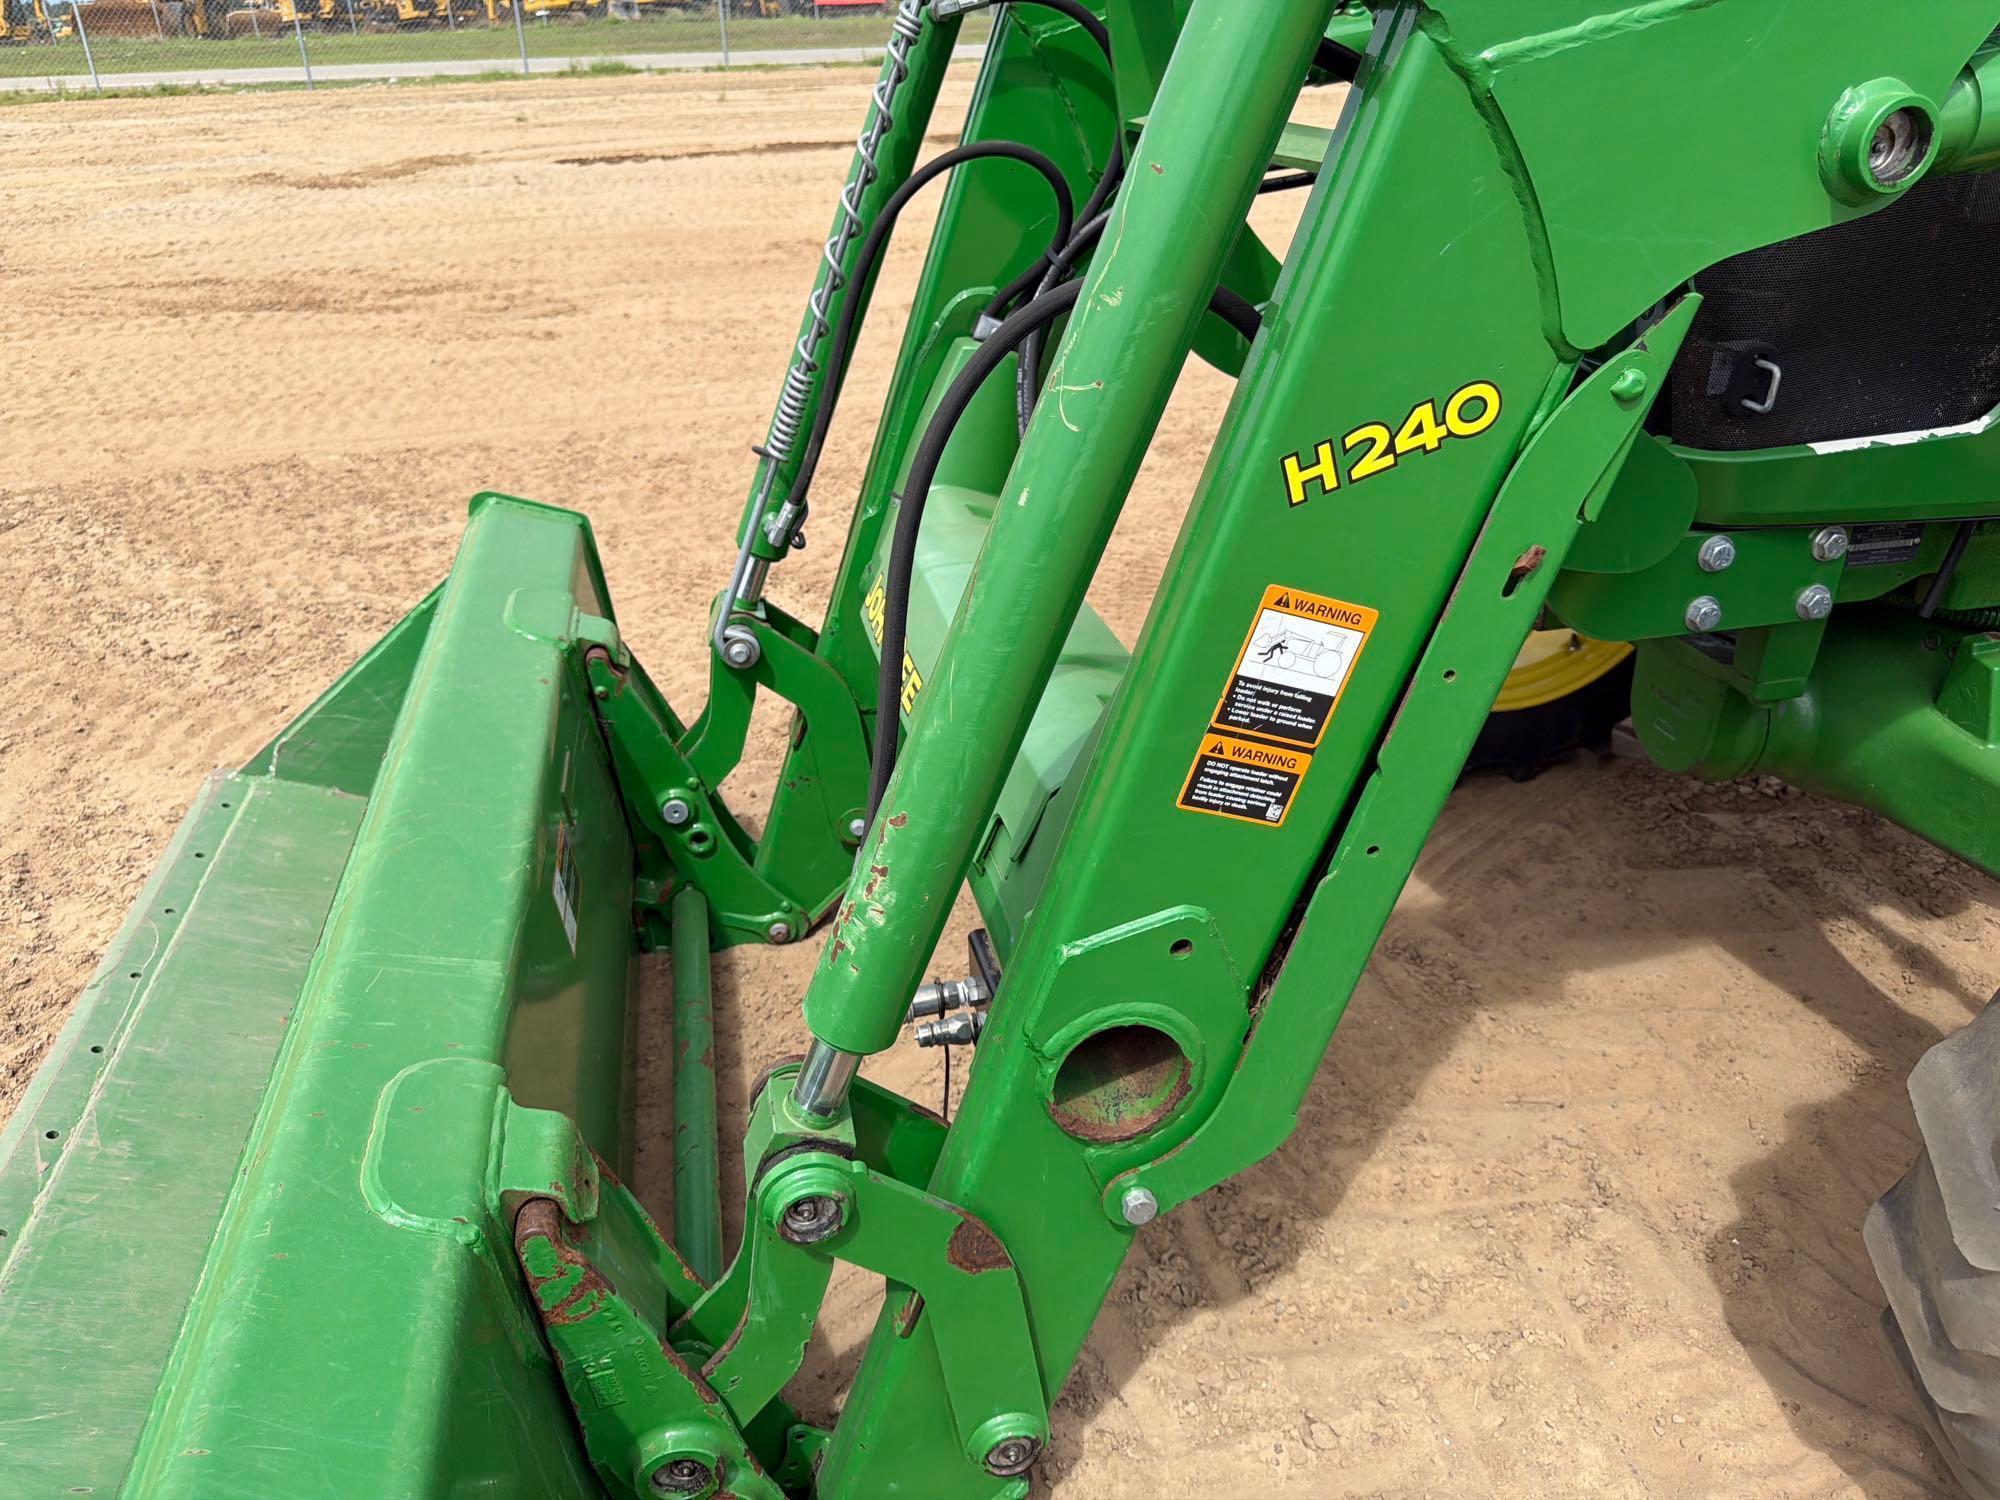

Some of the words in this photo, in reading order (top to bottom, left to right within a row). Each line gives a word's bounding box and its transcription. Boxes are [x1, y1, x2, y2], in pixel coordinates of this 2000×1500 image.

[1280, 380, 1502, 508] H240
[1294, 598, 1362, 625] WARNING
[1246, 682, 1262, 690] avoid
[1263, 686, 1279, 695] injury
[1294, 693, 1312, 702] falling
[1232, 707, 1250, 716] Lower
[1250, 712, 1268, 720] loader
[1276, 718, 1297, 726] ground
[1234, 702, 1256, 710] service
[1279, 712, 1297, 720] raised
[1278, 704, 1302, 713] perform
[1232, 746, 1297, 768] WARNING
[1200, 776, 1218, 784] Failure
[1204, 768, 1229, 777] engaging
[1229, 772, 1260, 782] attachment
[1250, 769, 1268, 778] loader
[1192, 794, 1208, 802] bodily
[1219, 787, 1250, 797] attachment
[1250, 793, 1276, 804] detaching
[1226, 795, 1246, 804] causing
